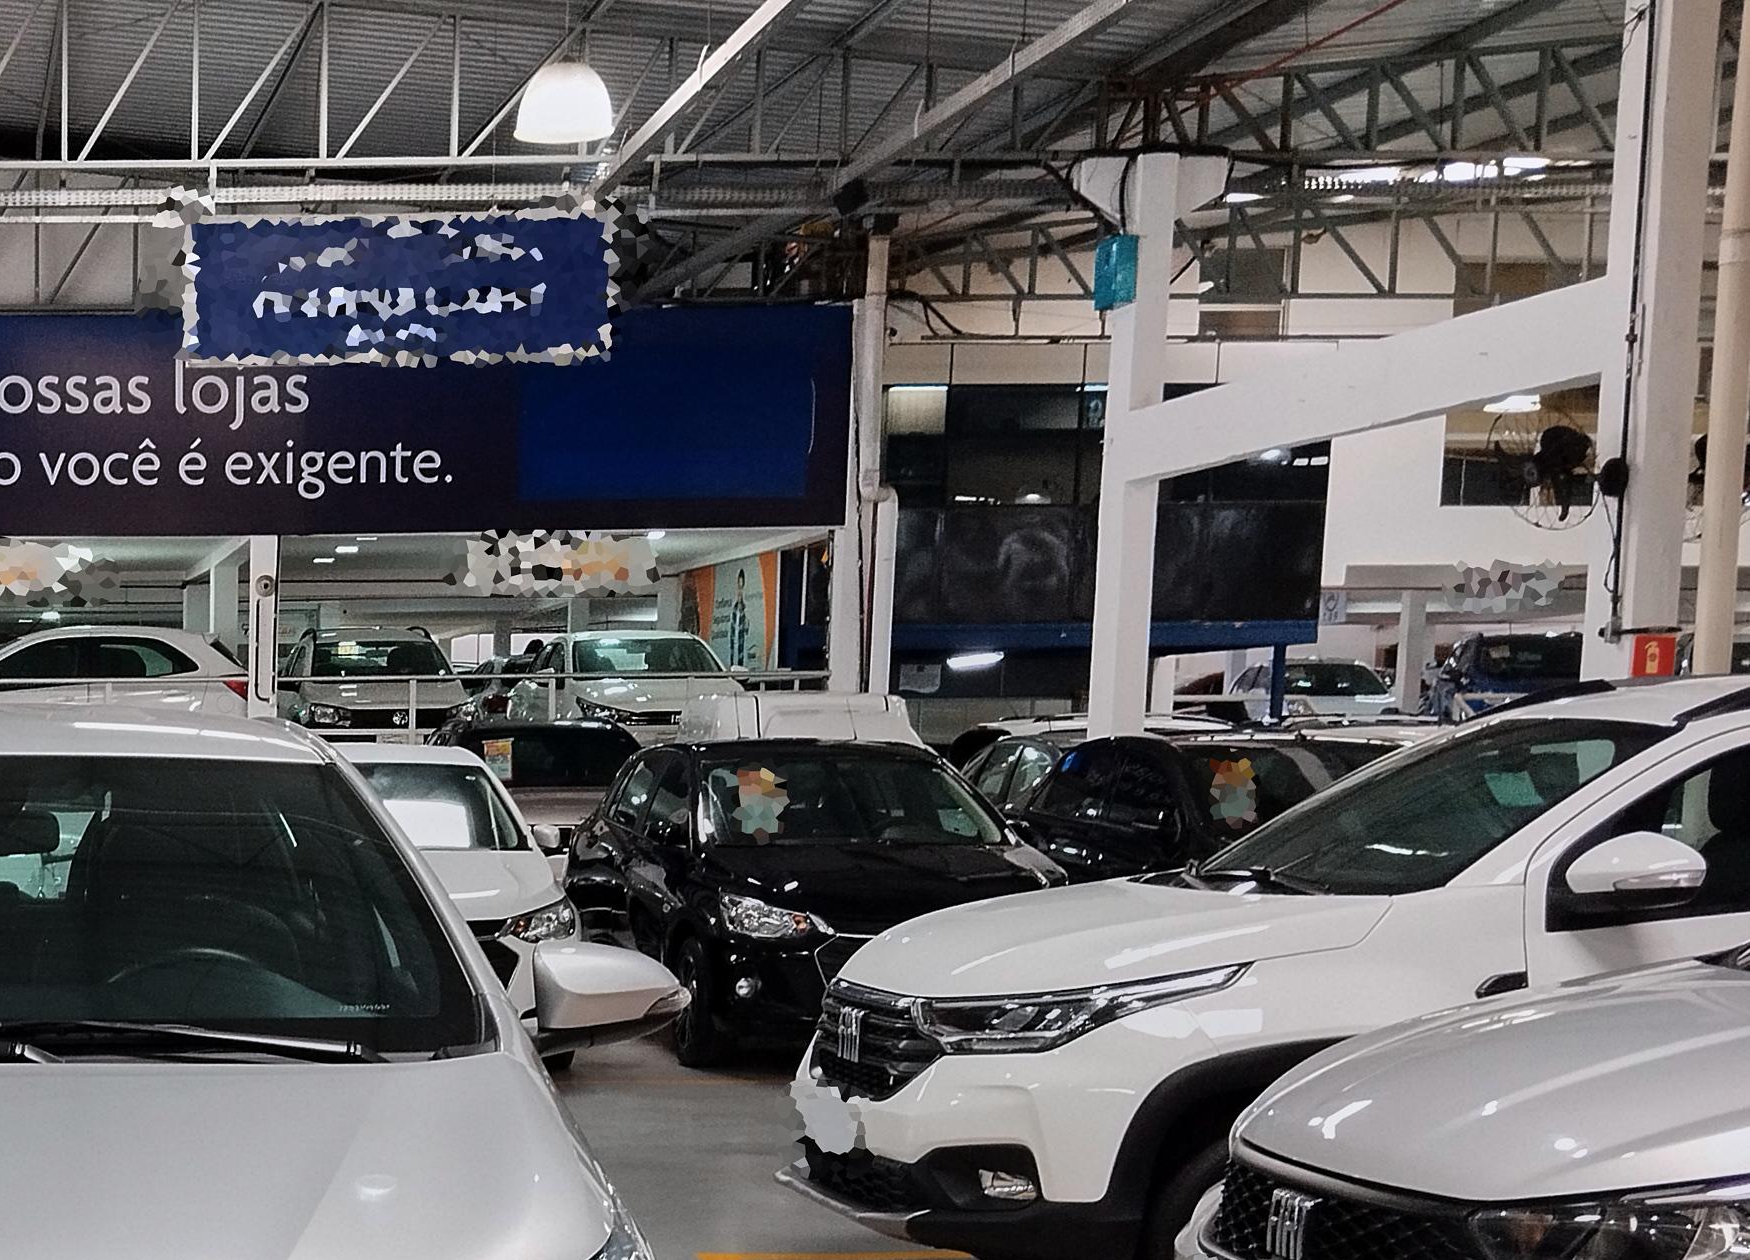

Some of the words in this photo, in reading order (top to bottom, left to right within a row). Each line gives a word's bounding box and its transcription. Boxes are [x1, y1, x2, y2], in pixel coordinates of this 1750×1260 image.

[175, 360, 311, 431] lojas
[39, 437, 162, 487] você
[178, 437, 207, 487] é
[225, 439, 454, 501] exigente.
